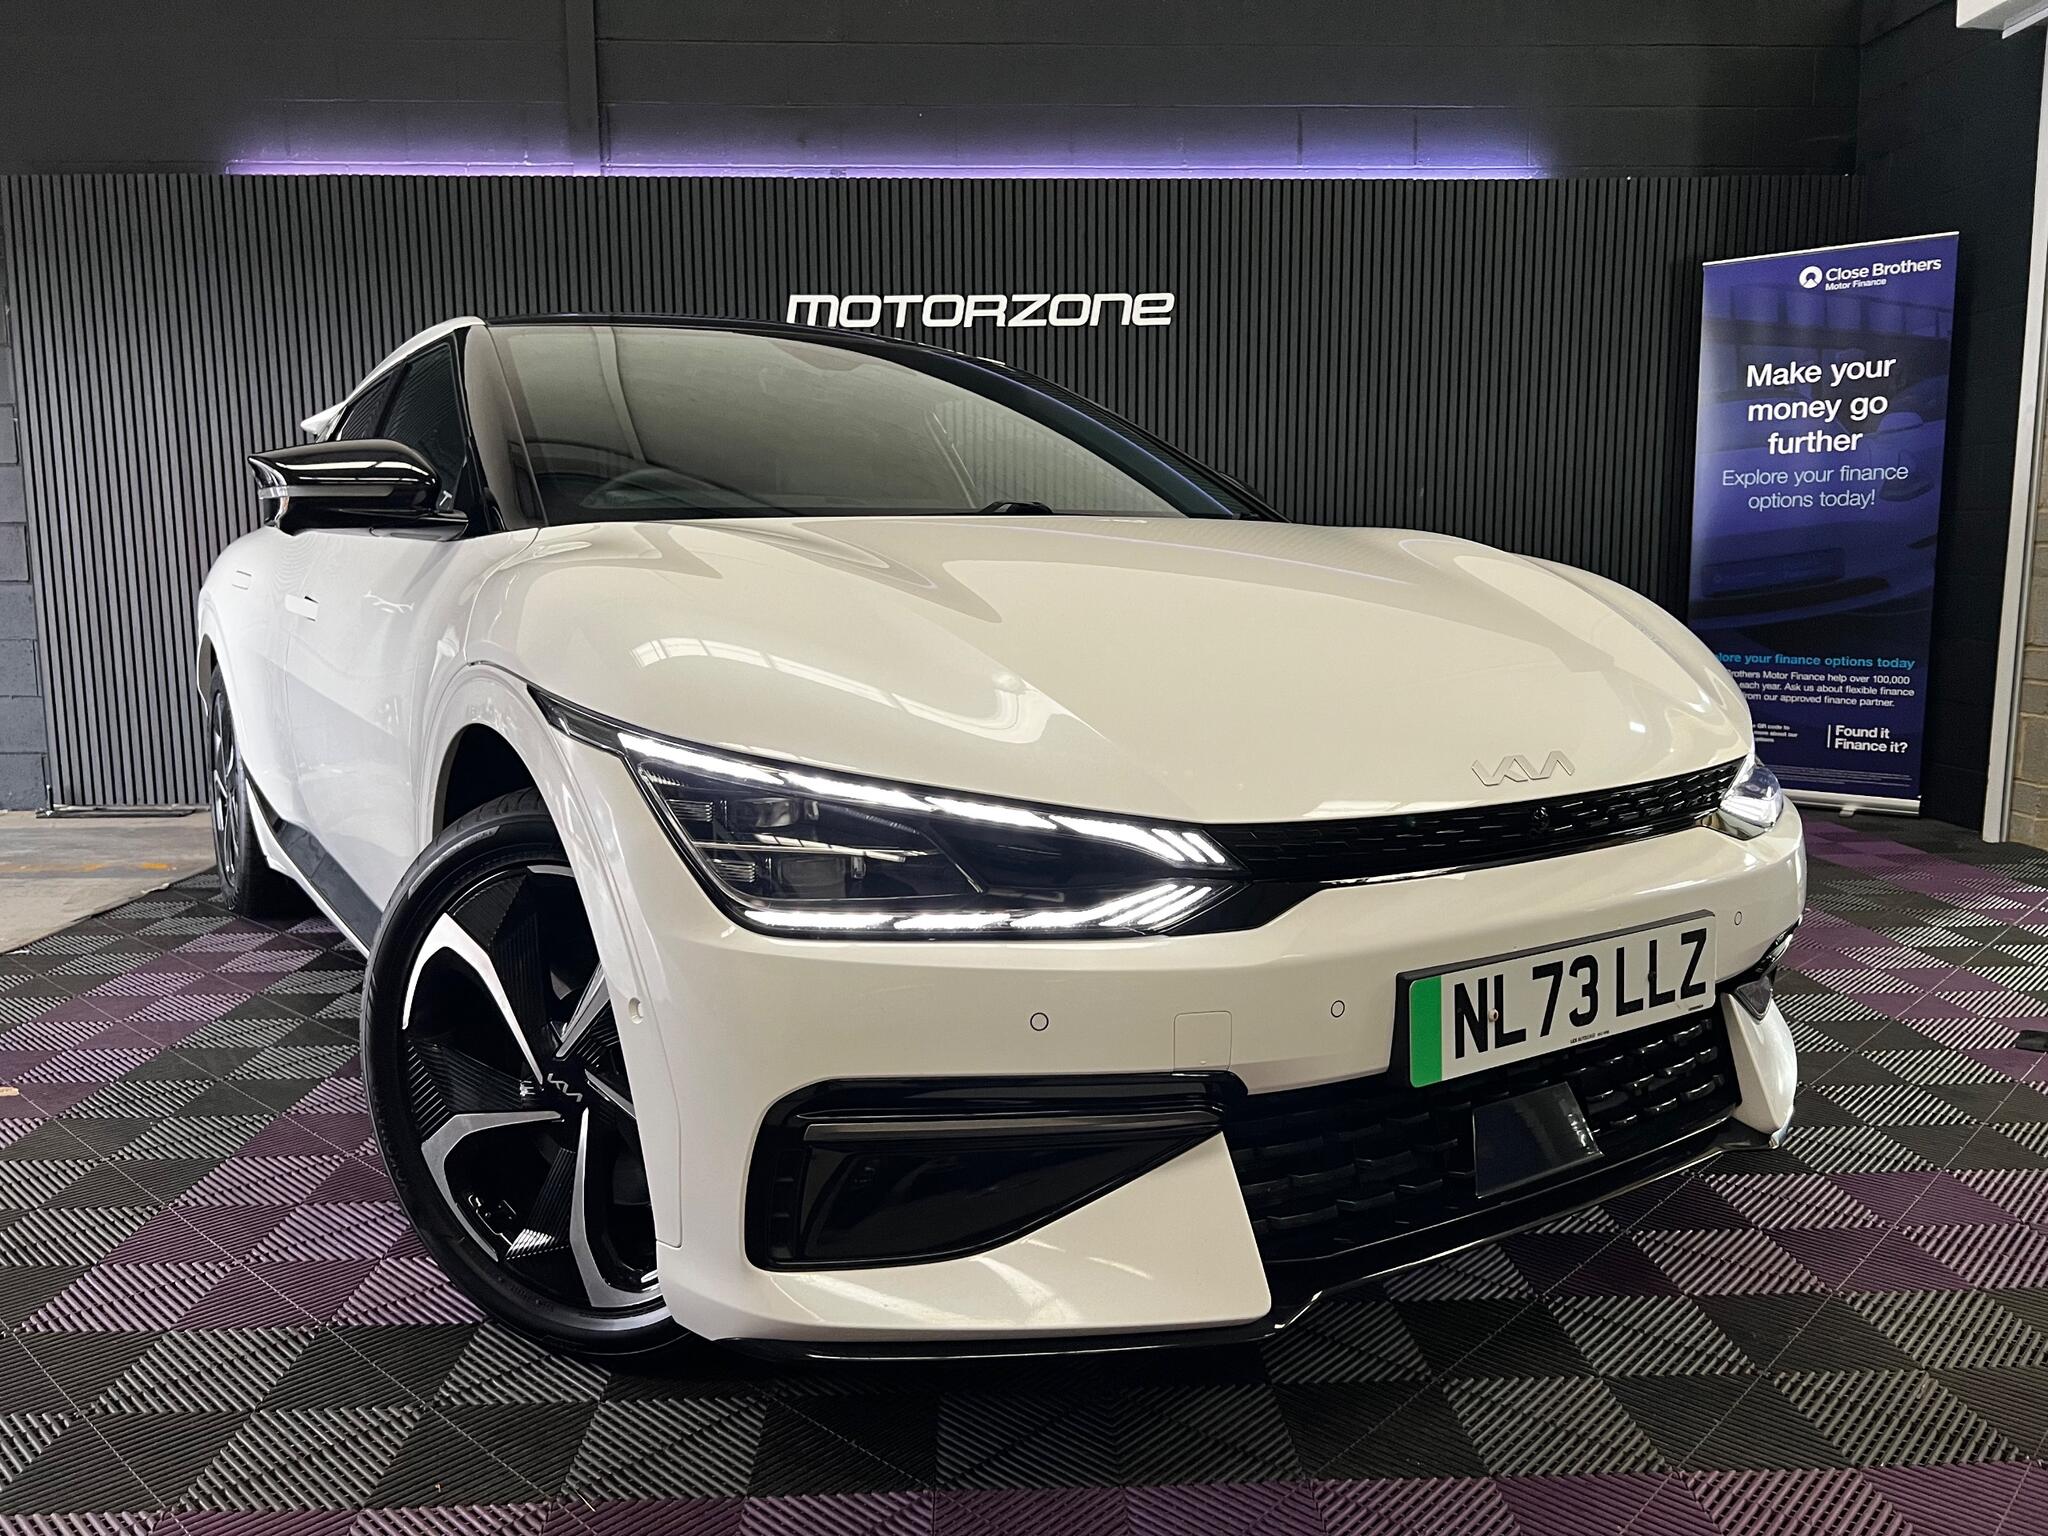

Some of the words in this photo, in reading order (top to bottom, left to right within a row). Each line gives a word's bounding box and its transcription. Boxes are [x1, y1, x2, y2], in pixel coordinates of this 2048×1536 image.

[1825, 267, 1869, 282] Close
[1872, 258, 1942, 277] Brothers
[1825, 281, 1851, 291] Motor
[1852, 278, 1887, 288] Finance
[1746, 361, 1822, 388] Make
[1830, 358, 1897, 387] your
[1747, 398, 1842, 423] money
[1850, 395, 1889, 421] go
[1767, 429, 1864, 455] further
[1722, 469, 1789, 489] Explore
[1793, 469, 1835, 487] your
[1839, 465, 1909, 482] finance
[1748, 492, 1814, 512] options
[1819, 488, 1876, 510] today!
[1715, 652, 1742, 663] lore
[1744, 654, 1773, 665] your
[1775, 653, 1821, 665] finance
[1824, 656, 1873, 668] options
[1877, 657, 1915, 670] today
[1762, 670, 1789, 680] Motor
[1790, 671, 1826, 682] Finance
[1827, 673, 1848, 684] help
[1849, 675, 1870, 683] over
[1873, 675, 1911, 685] 100,000
[1739, 681, 1760, 690] each
[1762, 682, 1782, 691] year.
[1783, 682, 1802, 692] Ask
[1803, 684, 1815, 692] us
[1816, 684, 1843, 693] about
[1845, 685, 1878, 695] flexible
[1880, 686, 1915, 697] finance
[1743, 691, 1762, 700] rom
[1763, 693, 1779, 701] our
[1780, 694, 1822, 704] approved
[1824, 695, 1857, 705] finance
[1859, 698, 1895, 707] partner.
[1835, 724, 1878, 738] Found
[1880, 727, 1890, 739] it
[1834, 737, 1888, 752] Finance
[1889, 741, 1908, 753] it?
[1454, 955, 1599, 1060] NL73
[1615, 927, 1708, 1018] LLZ
